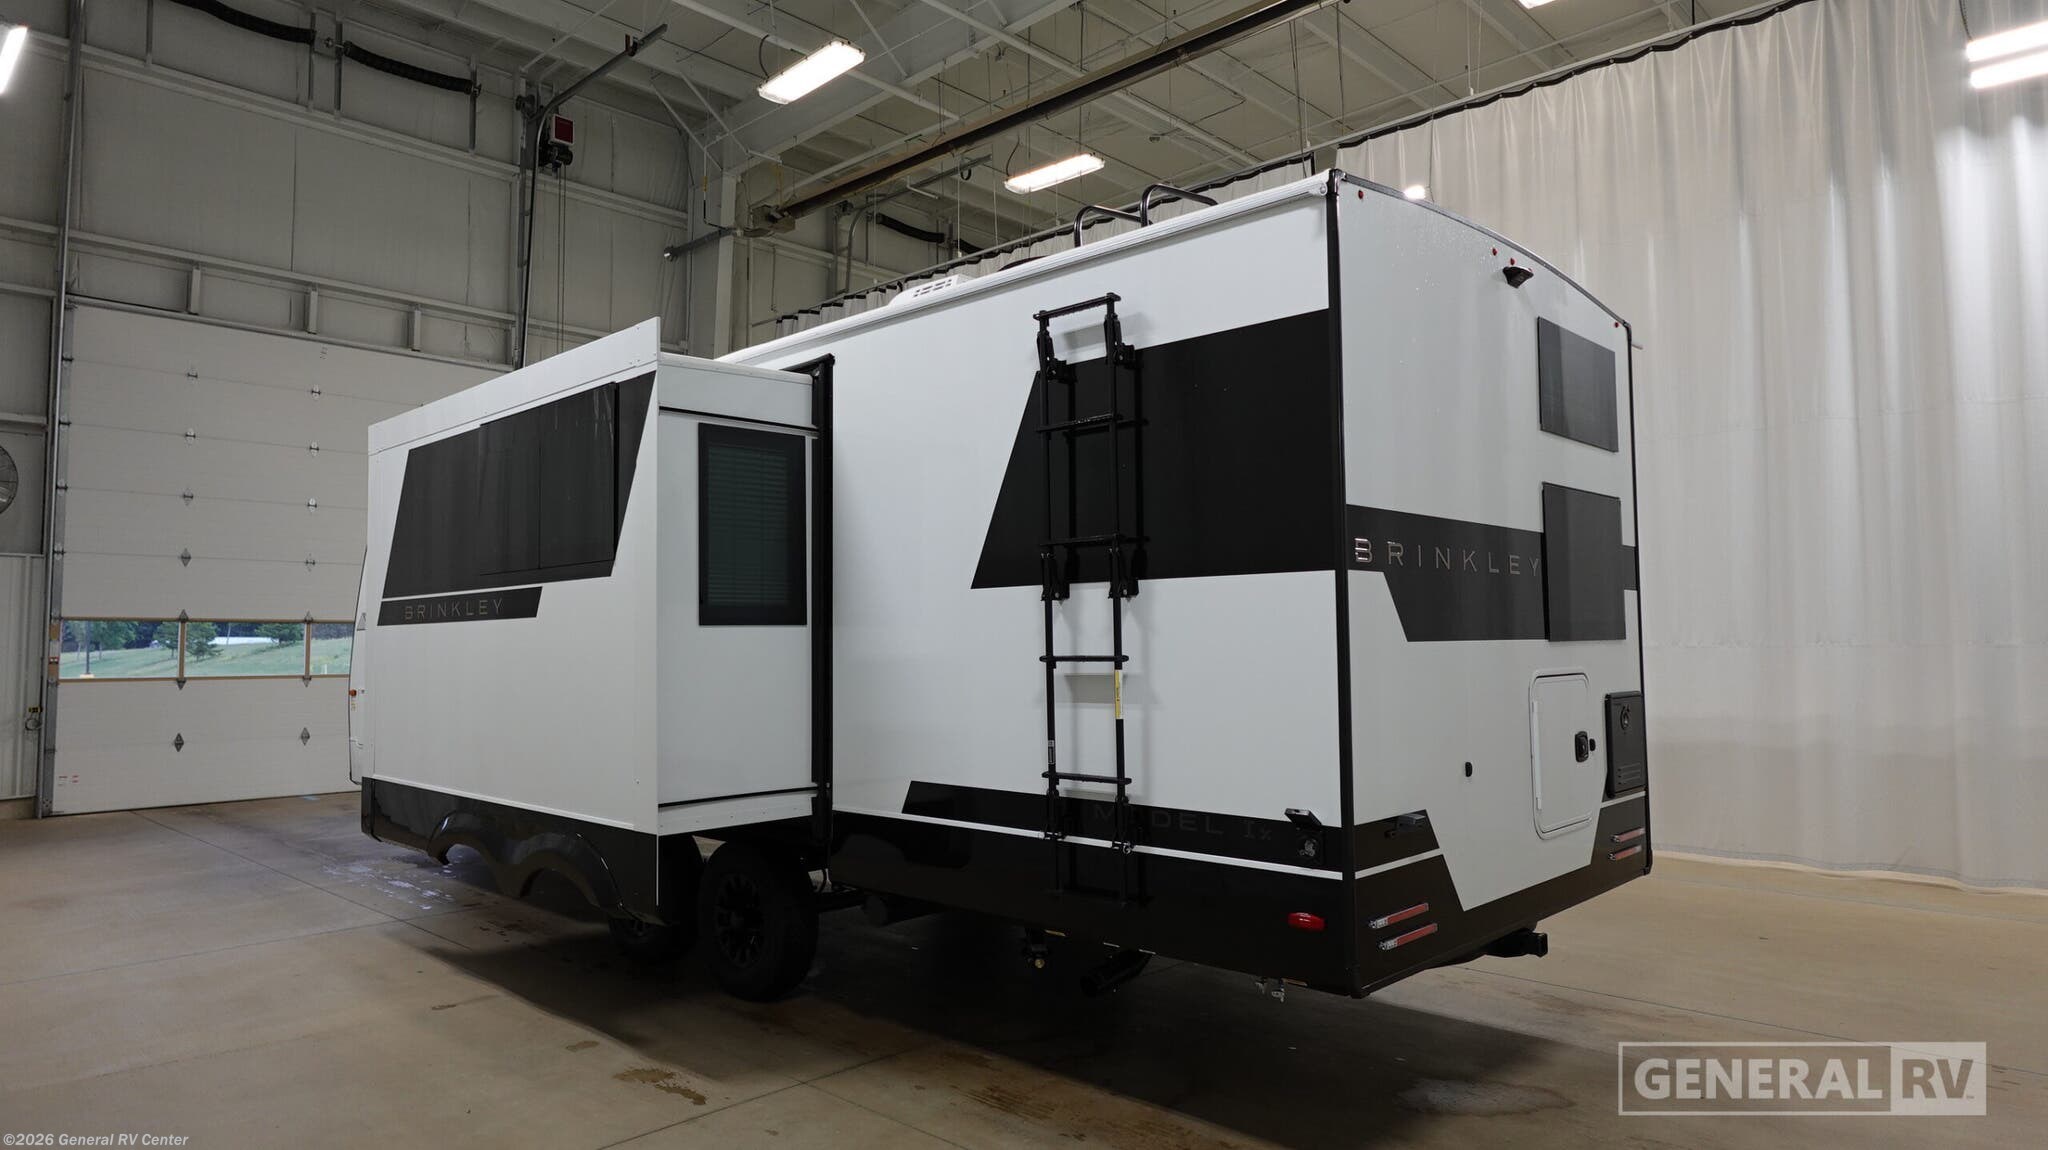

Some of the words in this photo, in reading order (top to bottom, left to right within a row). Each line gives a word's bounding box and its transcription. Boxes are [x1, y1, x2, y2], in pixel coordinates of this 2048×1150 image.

[1354, 537, 1540, 577] BRINKLEY
[404, 598, 503, 621] BRINKLEY
[1093, 804, 1225, 835] MDEL
